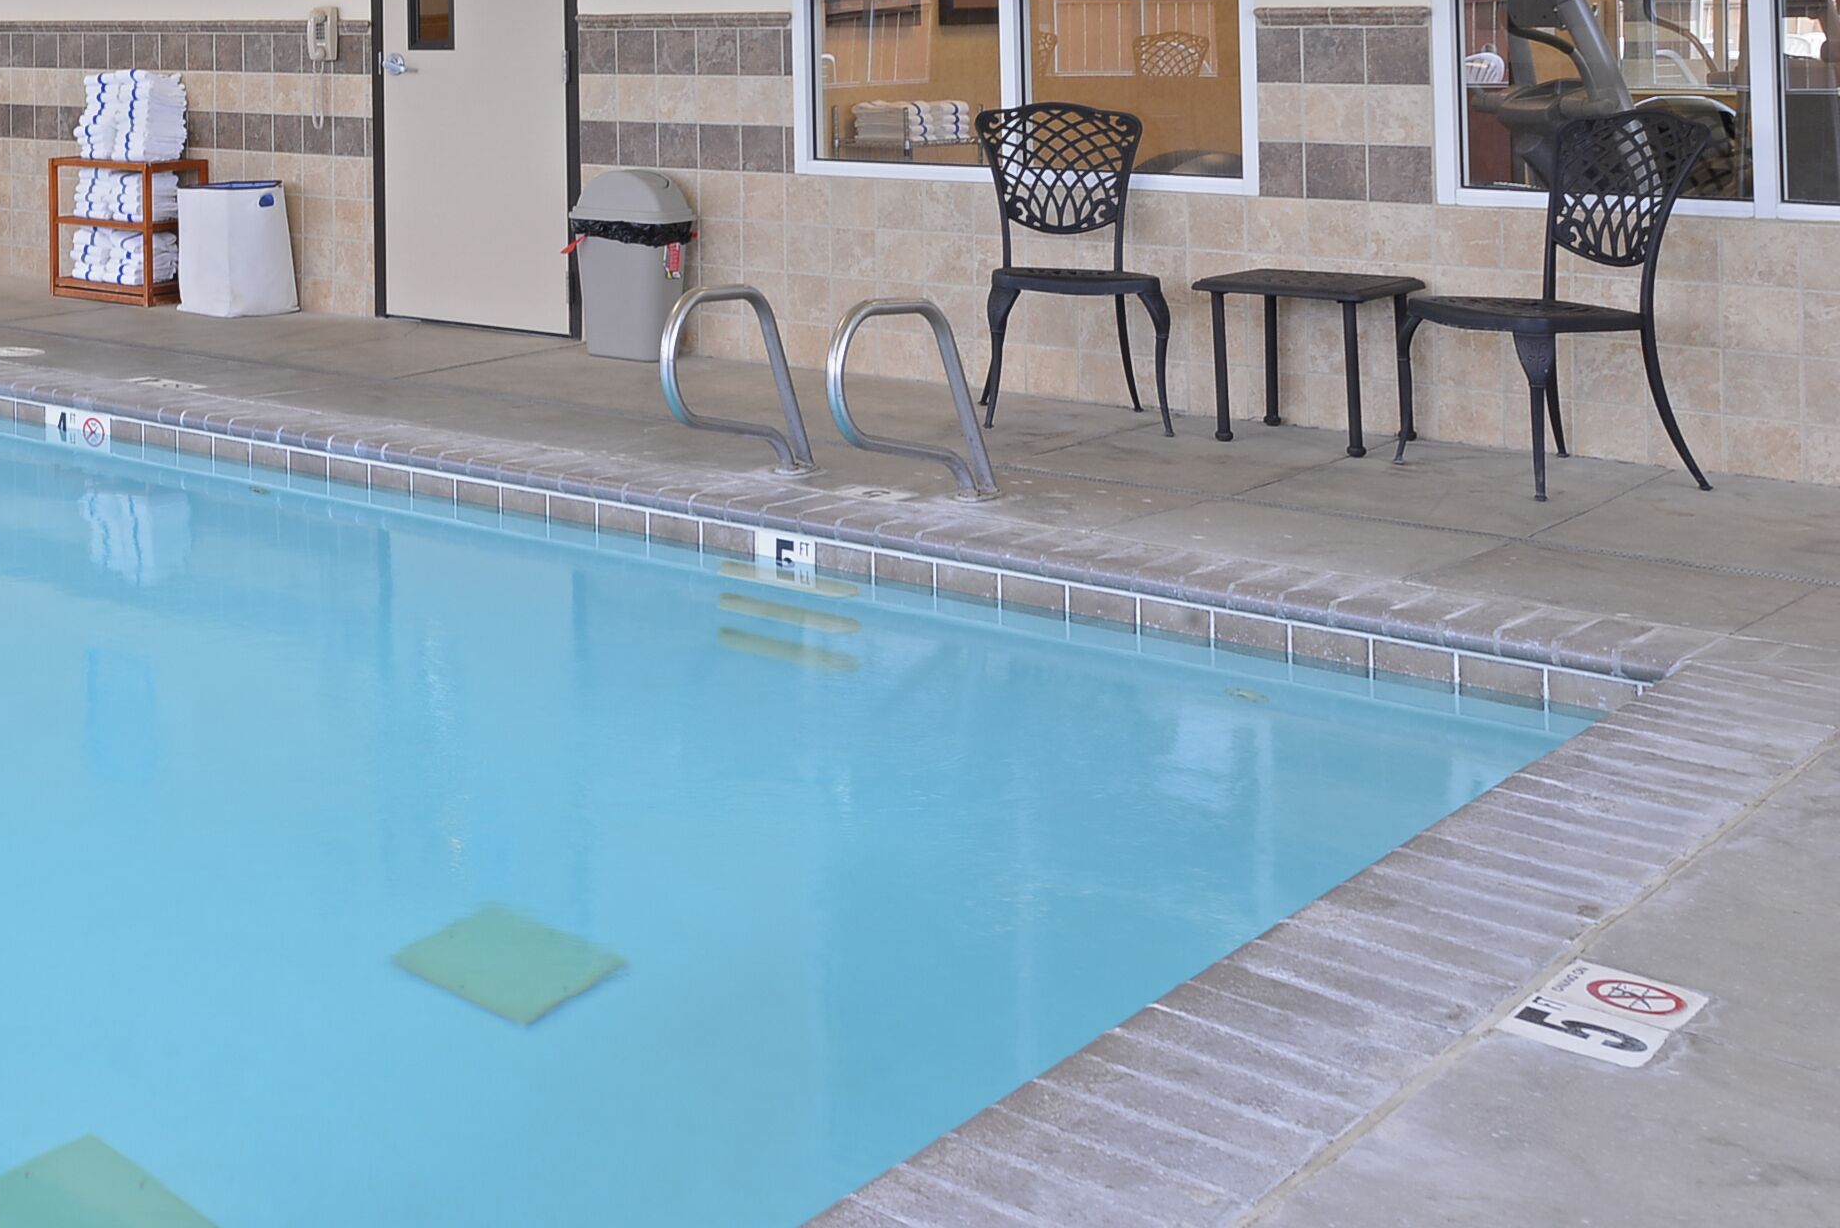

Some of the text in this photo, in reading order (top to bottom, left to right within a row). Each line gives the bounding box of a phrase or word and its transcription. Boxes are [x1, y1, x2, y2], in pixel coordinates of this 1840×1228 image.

[800, 542, 809, 556] FT
[1532, 996, 1567, 1011] FT
[1514, 1006, 1648, 1053] 5
